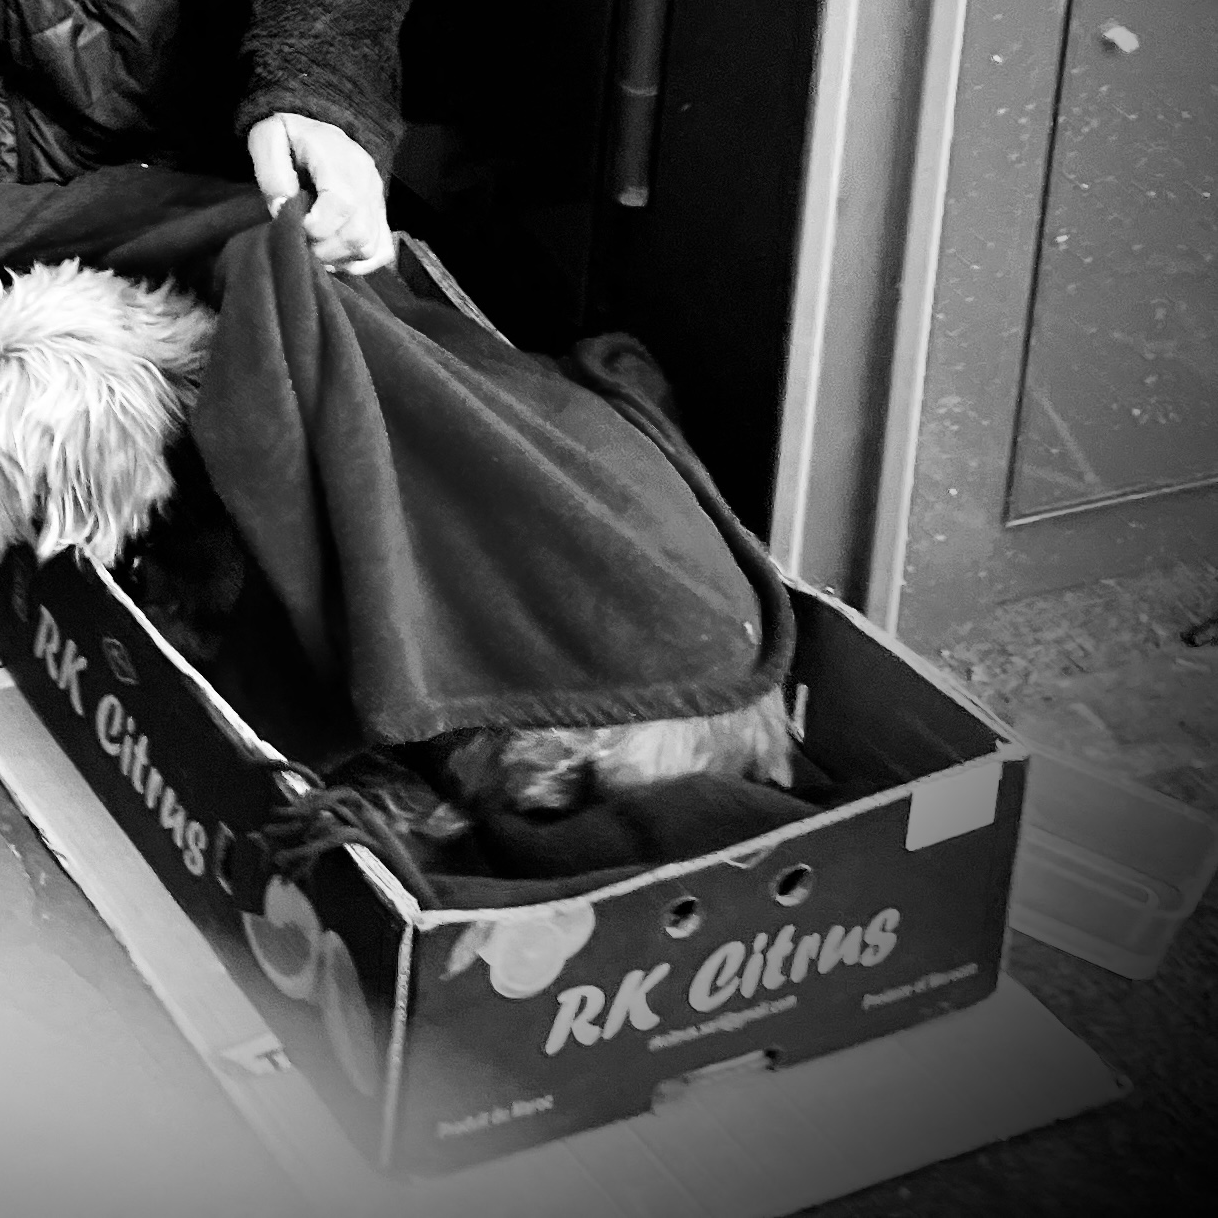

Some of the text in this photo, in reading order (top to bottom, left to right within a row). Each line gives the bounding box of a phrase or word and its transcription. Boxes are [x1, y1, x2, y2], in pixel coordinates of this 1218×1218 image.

[34, 603, 208, 876] RK Citrus
[545, 962, 671, 1056] RK
[688, 907, 901, 1013] Citrus
